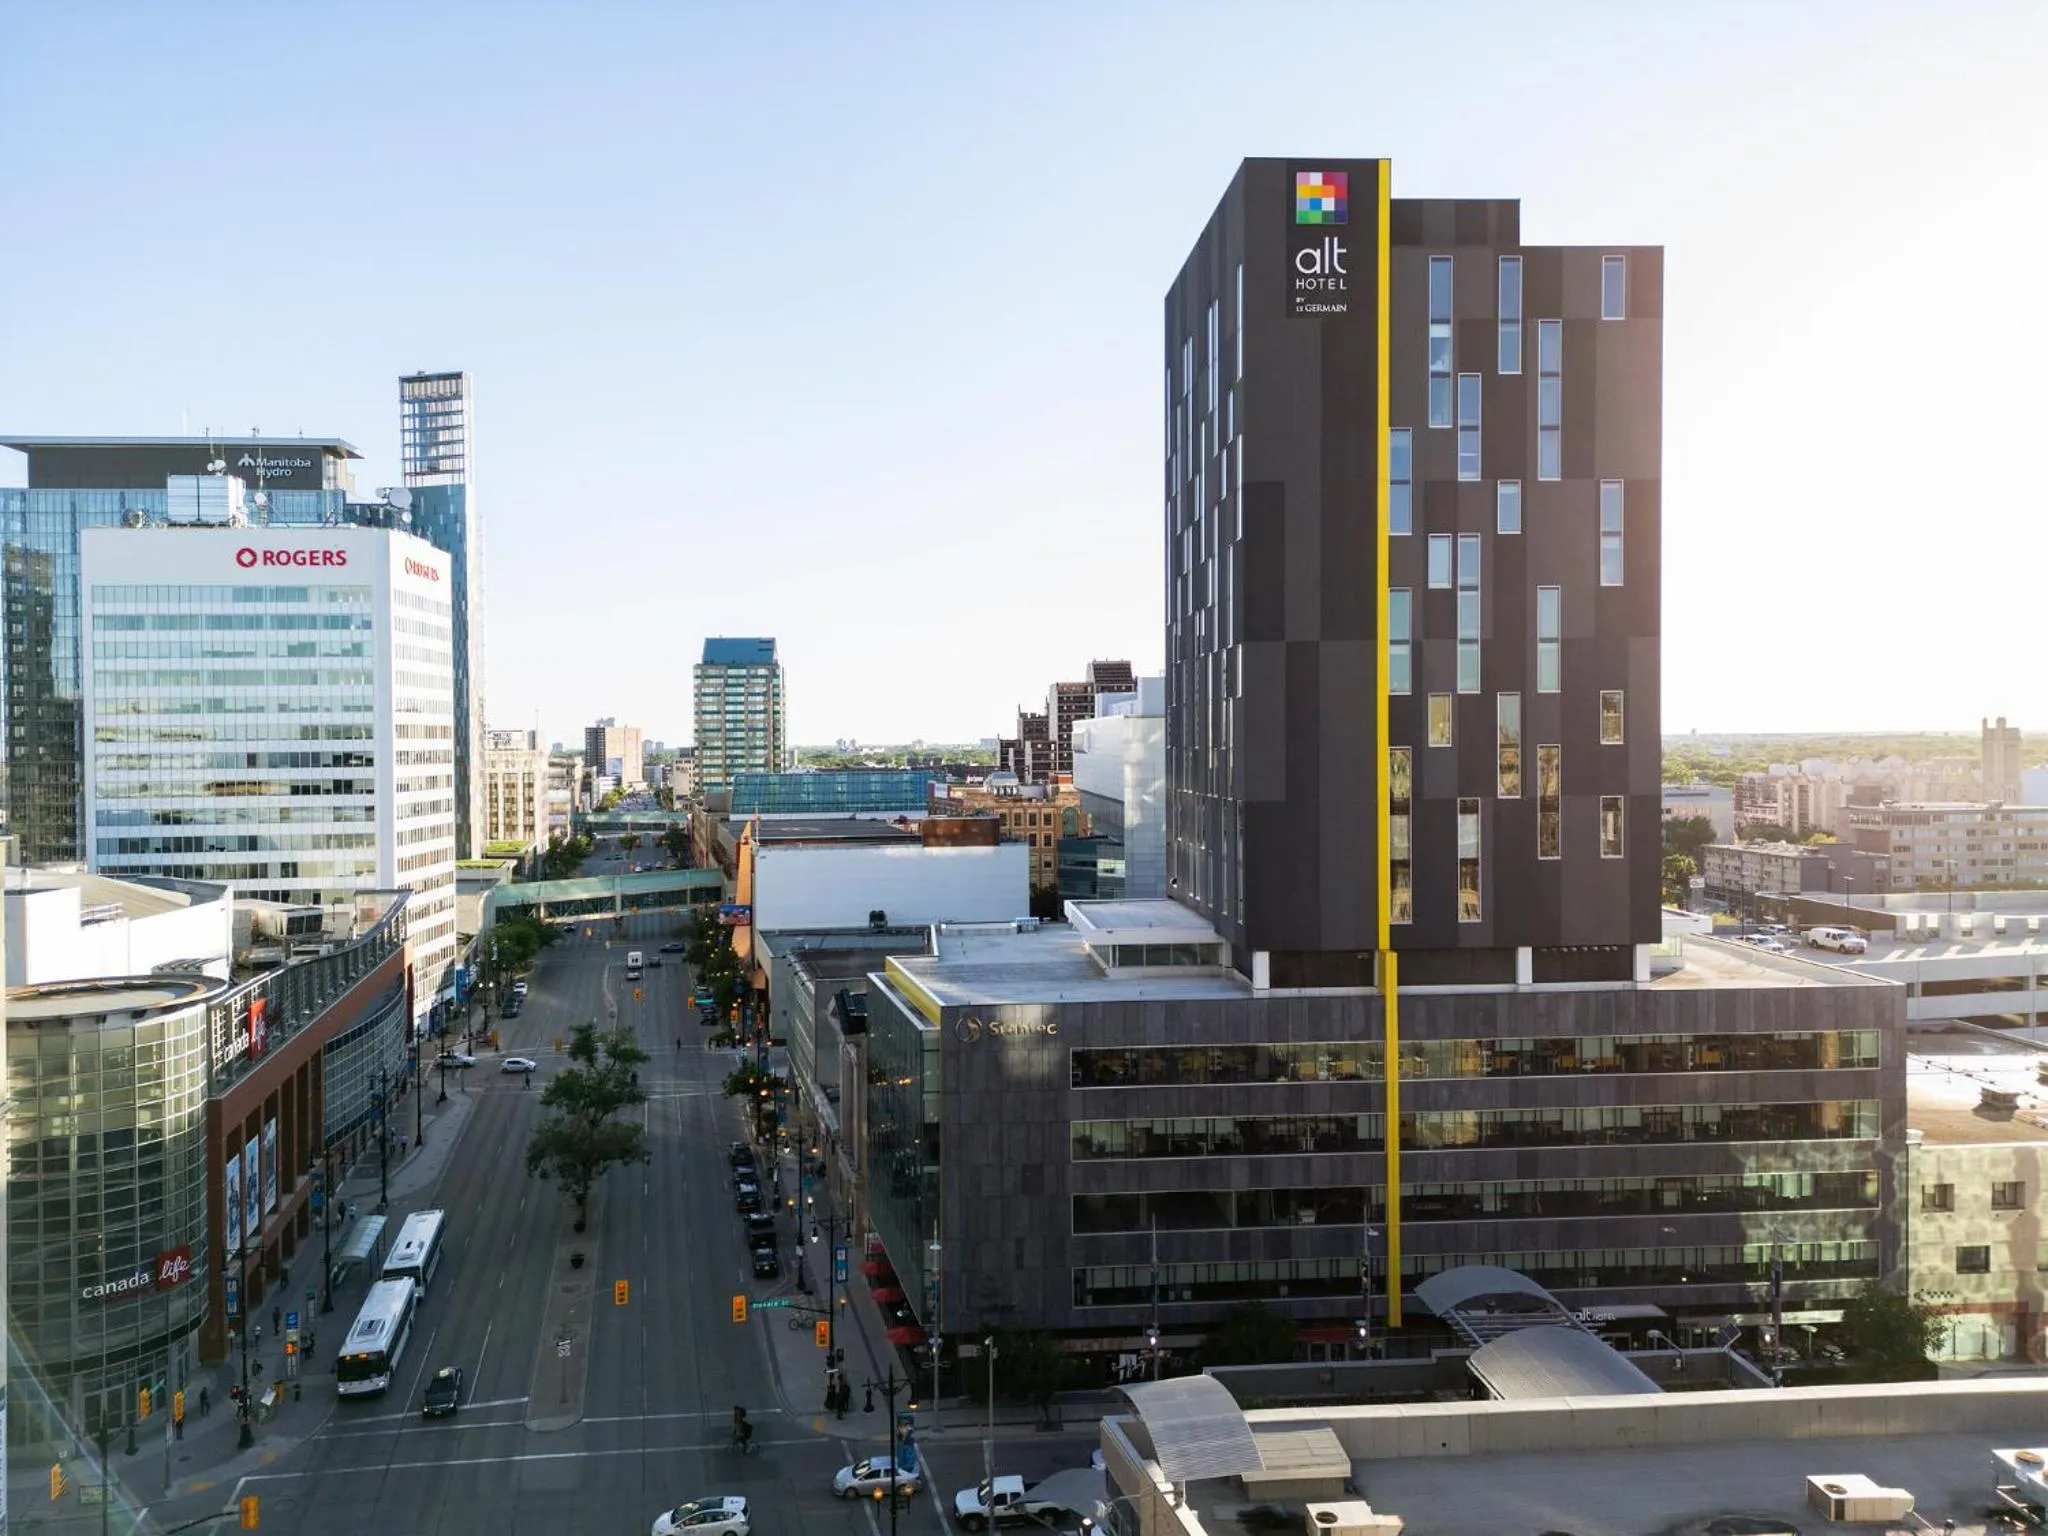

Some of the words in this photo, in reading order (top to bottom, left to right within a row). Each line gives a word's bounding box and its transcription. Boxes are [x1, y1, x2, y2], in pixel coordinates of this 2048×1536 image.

[1295, 236, 1347, 274] alt
[1295, 278, 1348, 290] HOTEL
[1305, 303, 1347, 312] GERMAIN
[256, 458, 312, 467] Manitoba
[256, 467, 292, 478] Hydro
[262, 550, 347, 566] ROGERS
[82, 1271, 149, 1299] canada
[158, 1255, 191, 1283] life
